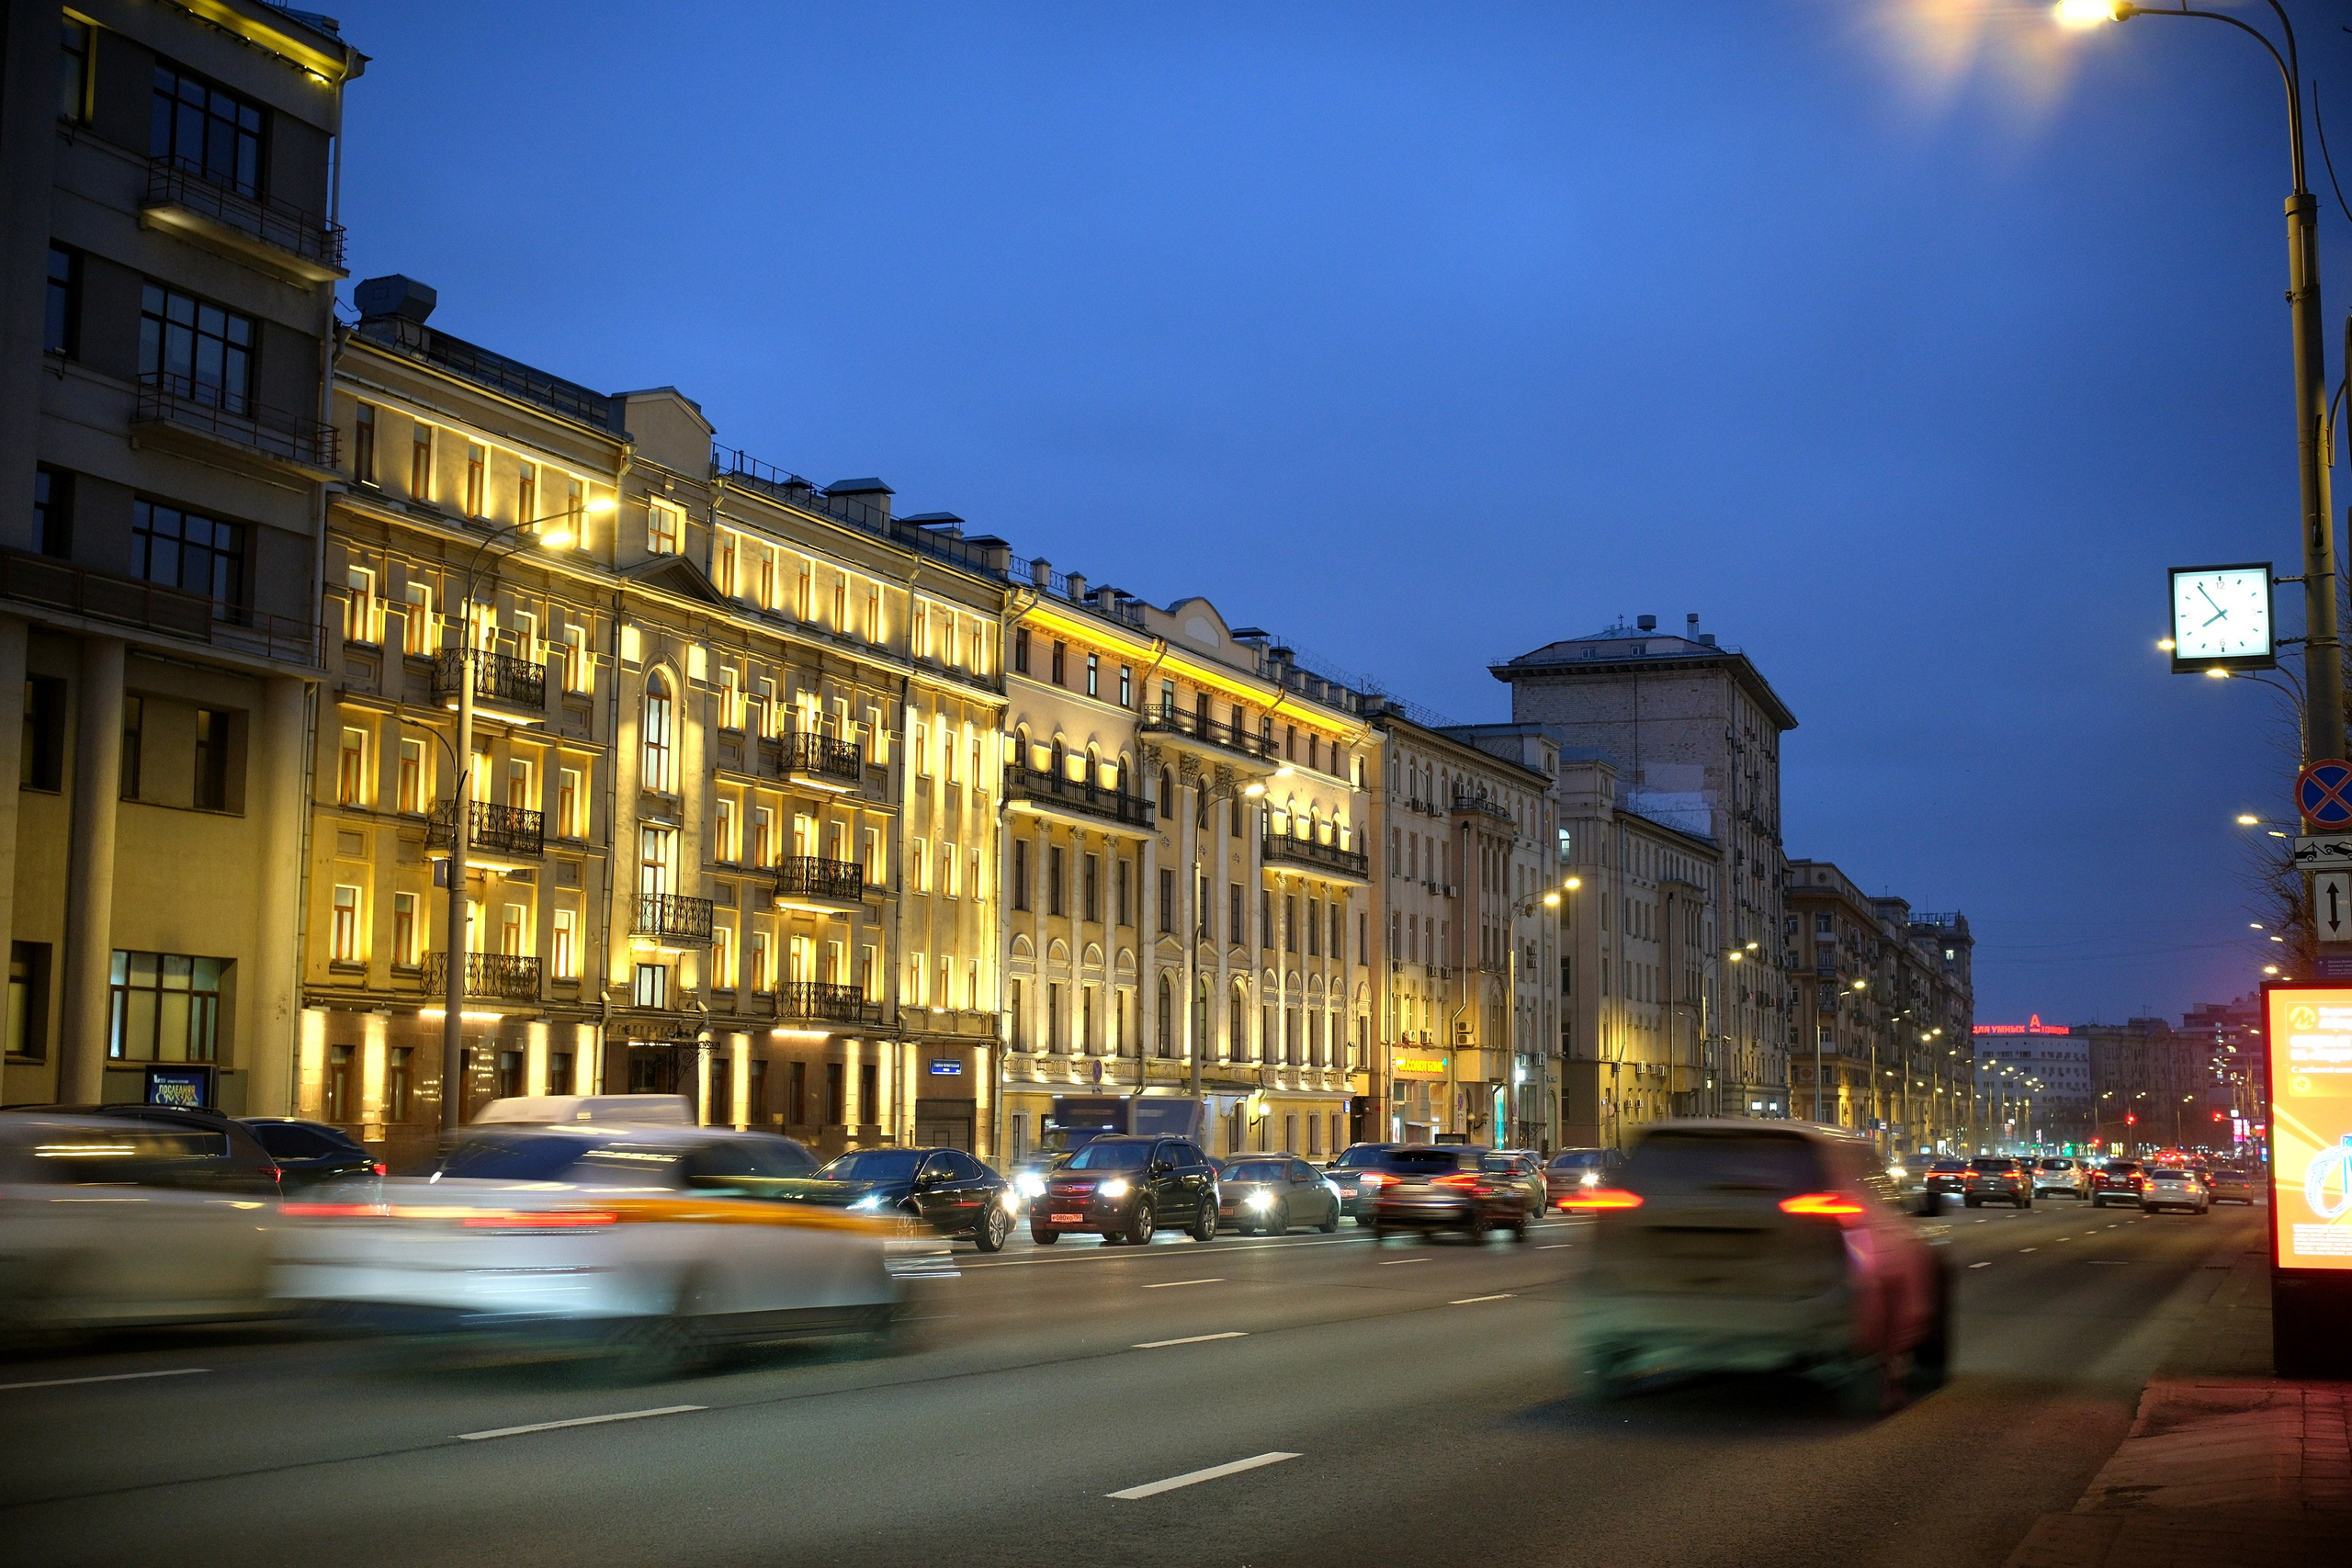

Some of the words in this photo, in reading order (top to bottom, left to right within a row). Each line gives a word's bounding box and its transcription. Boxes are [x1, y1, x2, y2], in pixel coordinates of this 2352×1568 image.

[2216, 581, 2225, 590] 12
[2220, 638, 2225, 647] 6
[1991, 1025, 2026, 1034] УМНЫХ
